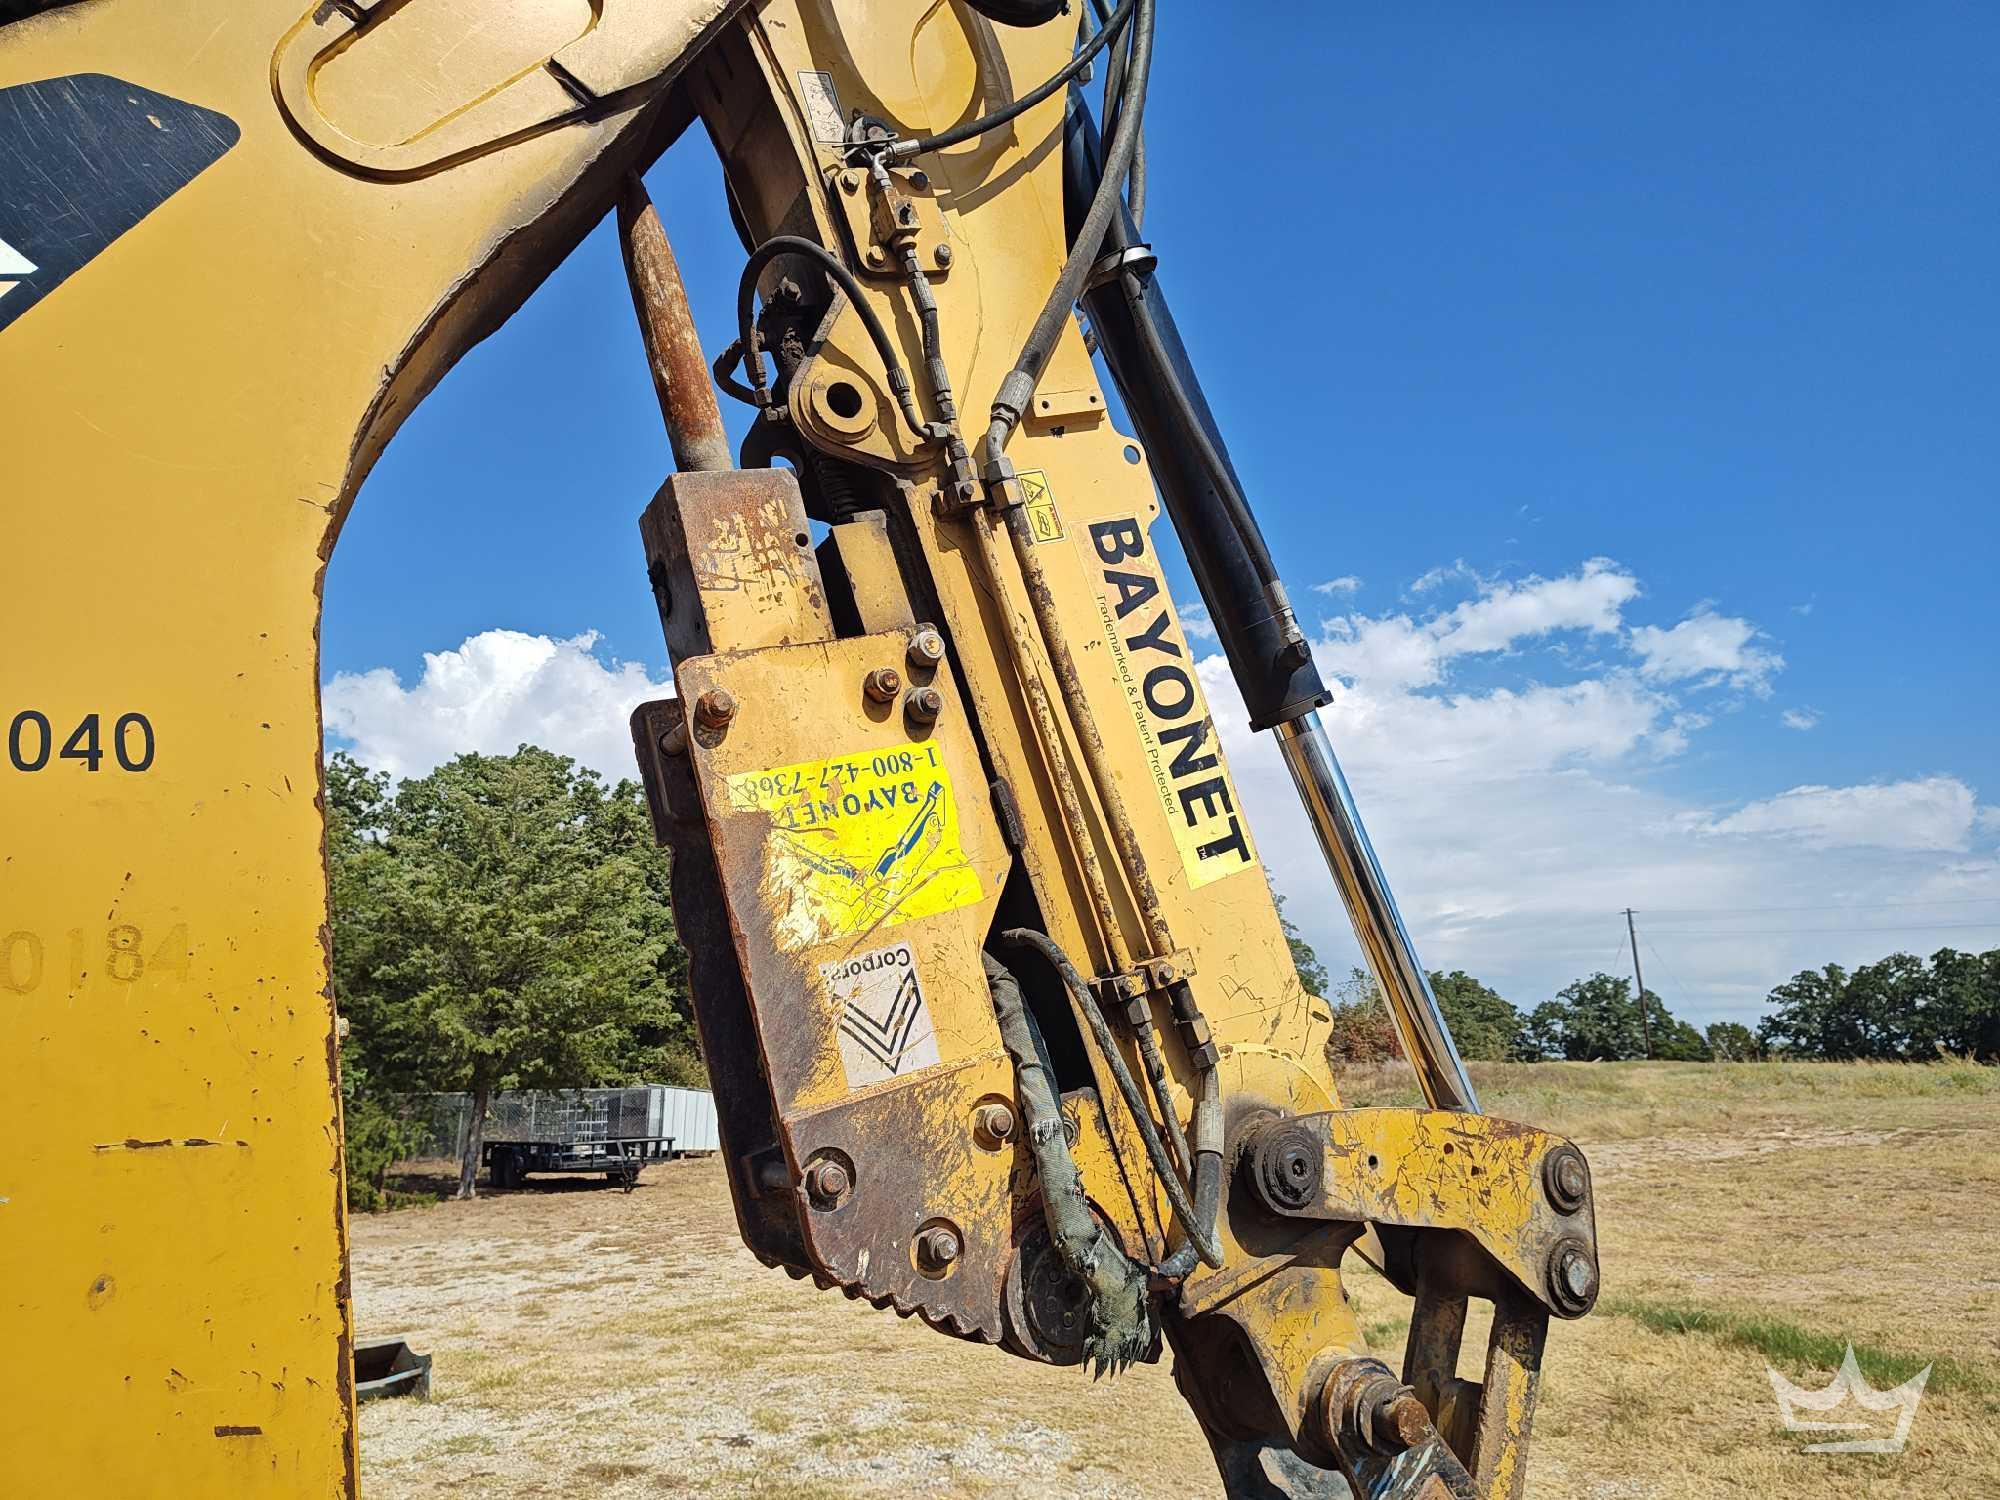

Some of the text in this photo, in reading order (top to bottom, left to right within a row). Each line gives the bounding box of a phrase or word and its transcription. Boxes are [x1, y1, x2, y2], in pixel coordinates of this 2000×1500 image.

[8, 710, 155, 773] 040
[1088, 517, 1252, 864] BAYONET
[1096, 594, 1179, 815] Trademarked & Patent Protected
[785, 781, 919, 829] BAYONET
